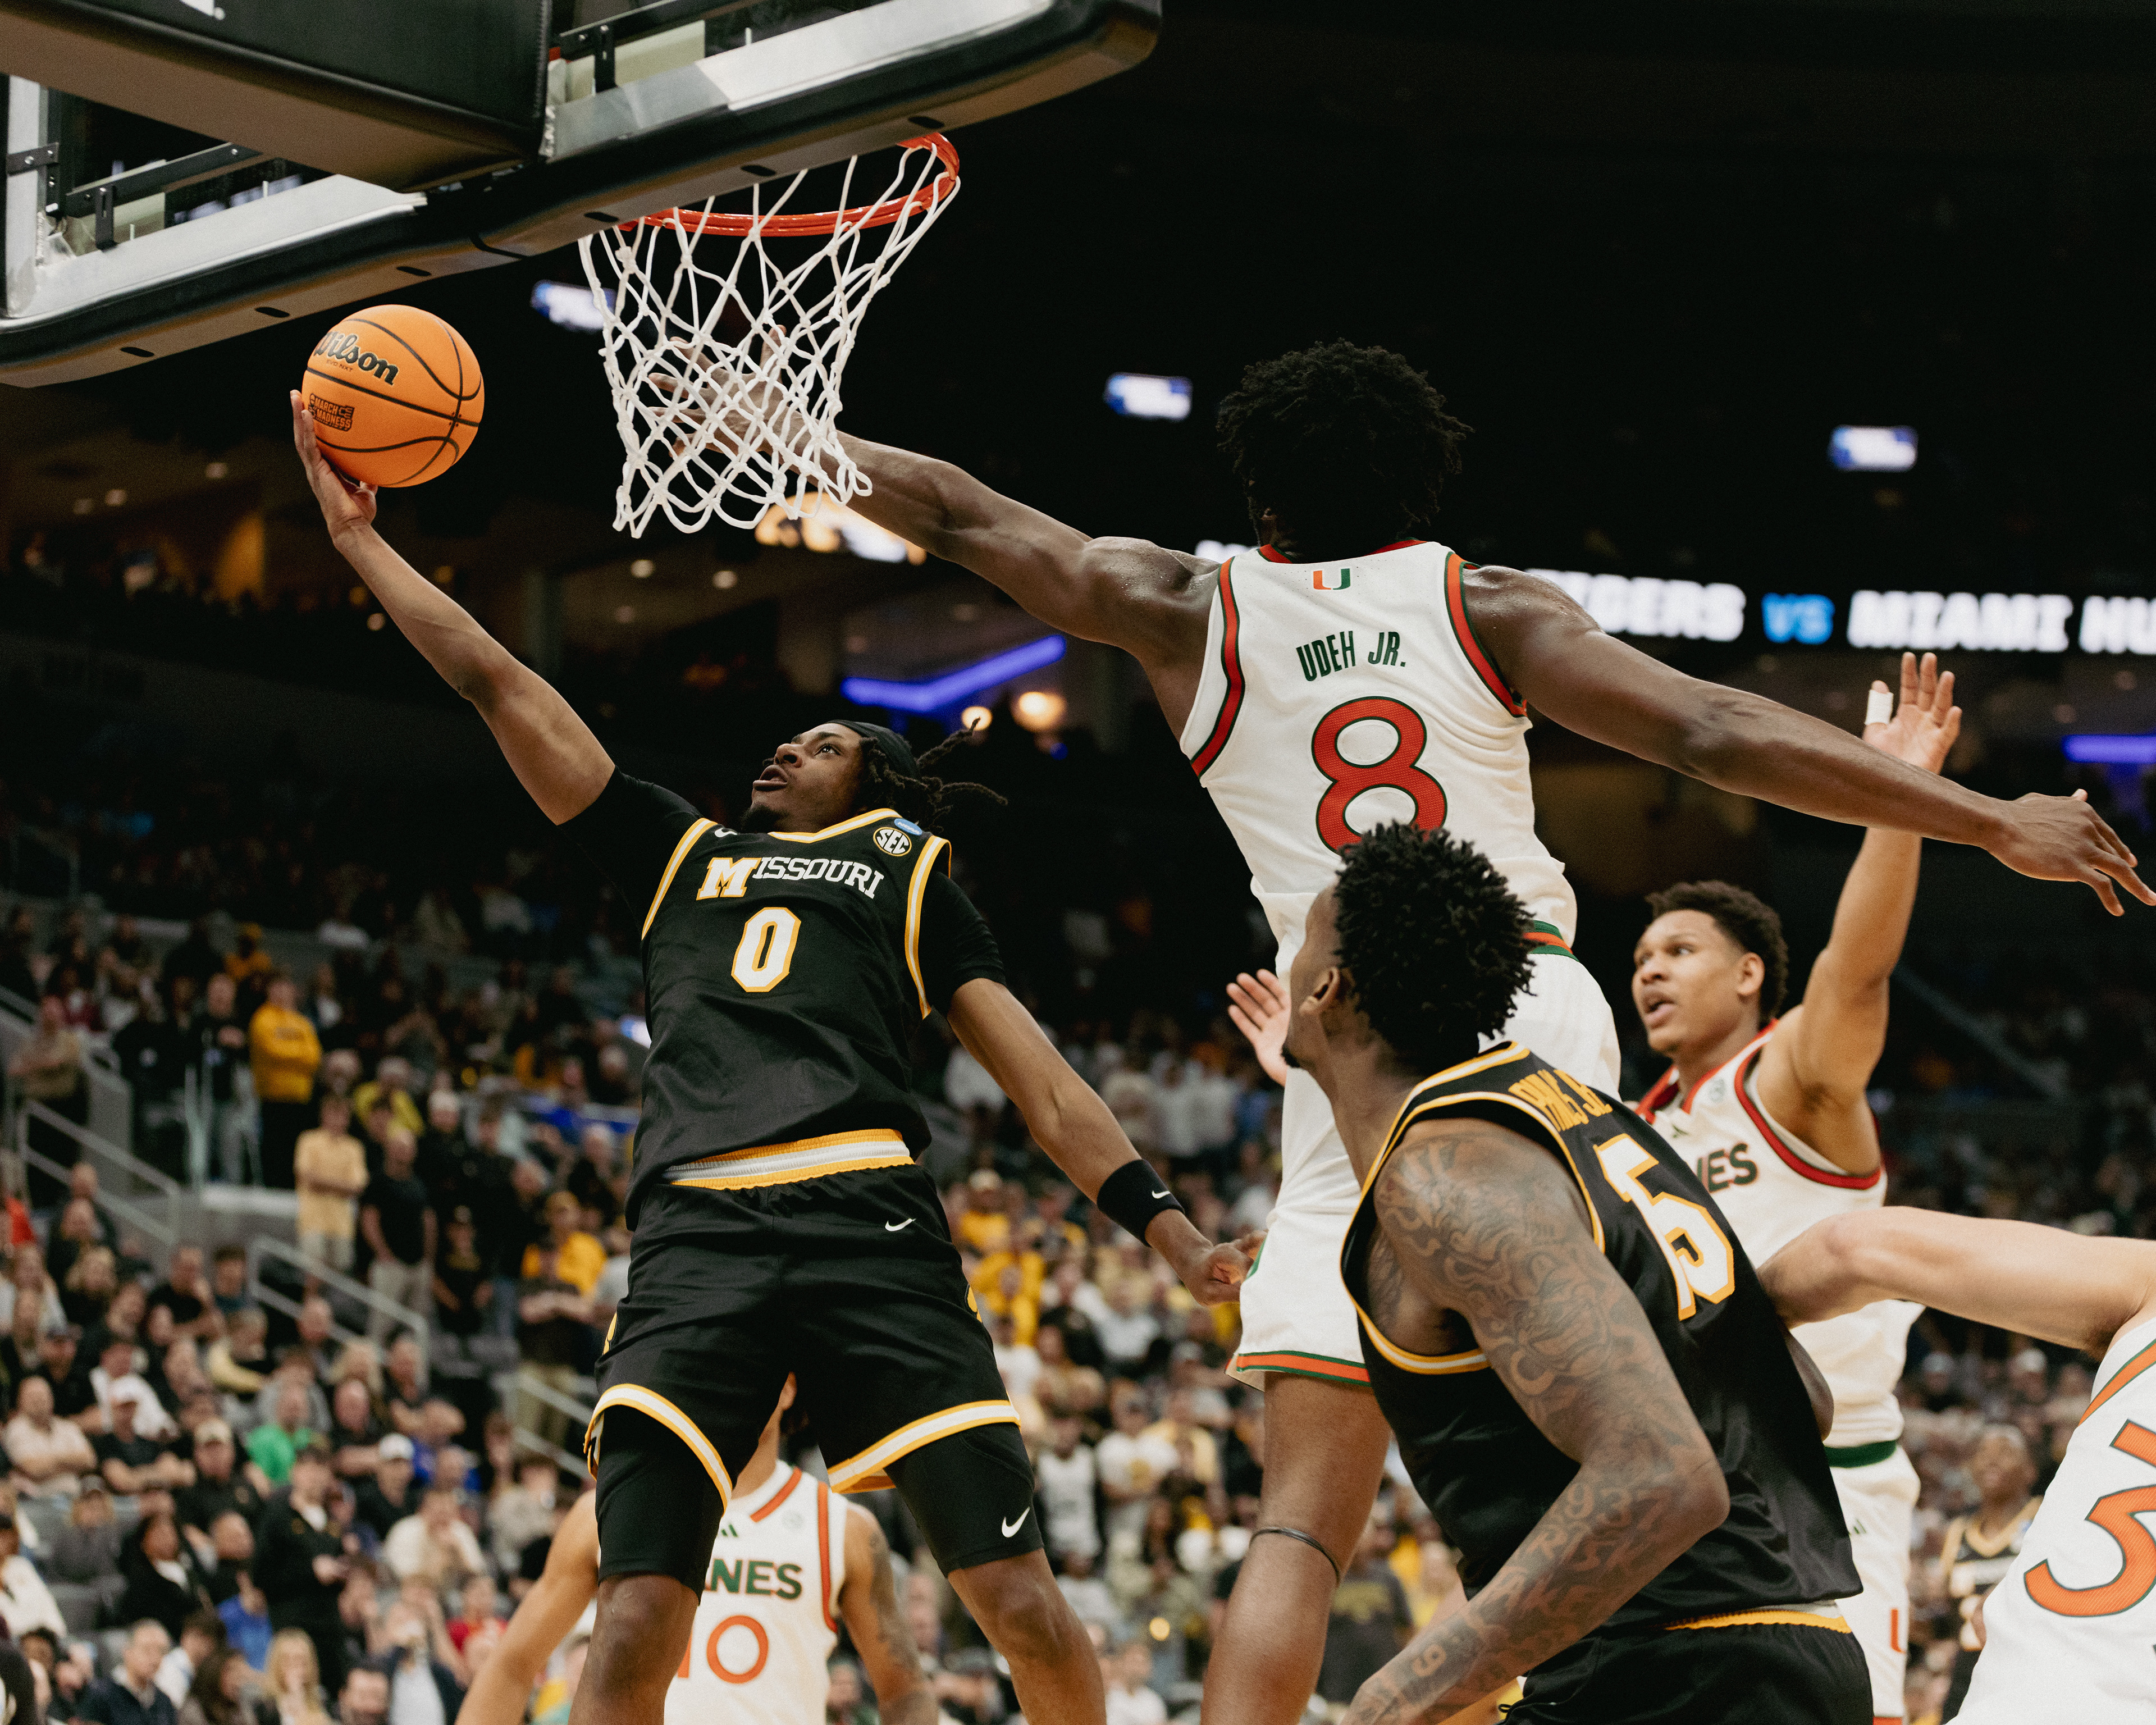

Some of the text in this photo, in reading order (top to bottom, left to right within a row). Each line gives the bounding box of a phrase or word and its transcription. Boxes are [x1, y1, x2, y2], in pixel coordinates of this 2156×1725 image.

[313, 331, 399, 386] Wilson
[339, 363, 353, 372] NXT
[314, 396, 339, 416] MARCH
[316, 408, 351, 429] MADNESS
[1761, 592, 1835, 644] VS
[1847, 590, 2074, 653] MIAMI
[1296, 630, 1406, 682] UDEH JR.
[1312, 696, 1448, 856] 8
[876, 828, 910, 854] SEC
[696, 857, 884, 901] MISSOURI
[731, 907, 801, 992] 0
[1696, 1142, 1758, 1194] ES
[705, 1559, 803, 1600] NES
